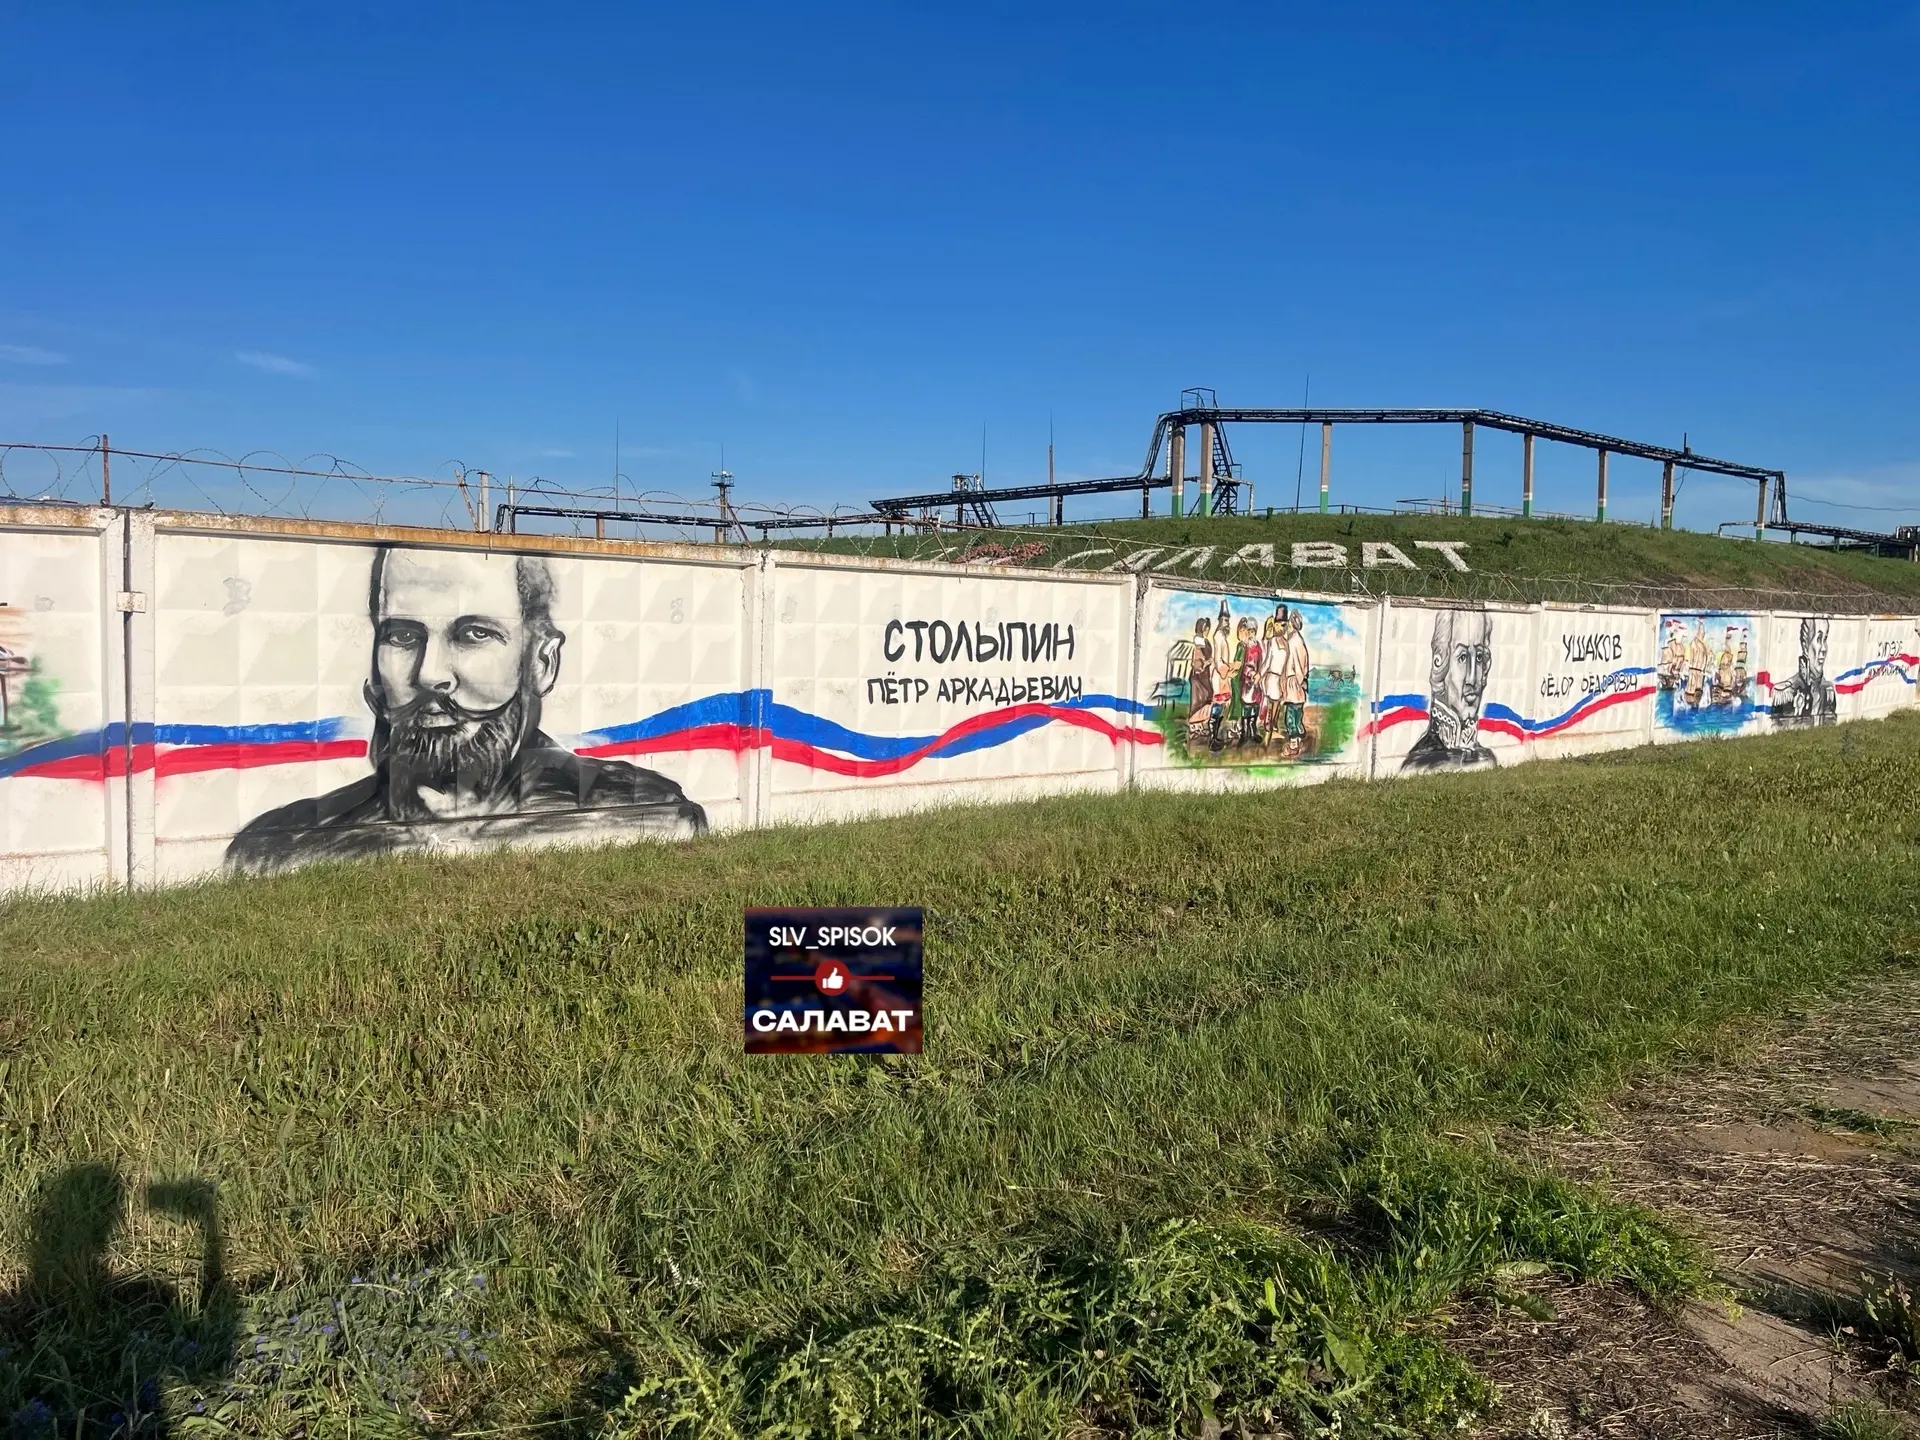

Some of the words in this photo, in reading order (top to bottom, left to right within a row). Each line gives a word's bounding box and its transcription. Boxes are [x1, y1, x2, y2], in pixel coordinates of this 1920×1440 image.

[884, 619, 1075, 664] СТОЛЫПИН
[1562, 633, 1622, 662] УШАКОВ
[867, 671, 929, 704] ПЁТР
[936, 675, 1083, 706] АРКАДЬЕВИЧ
